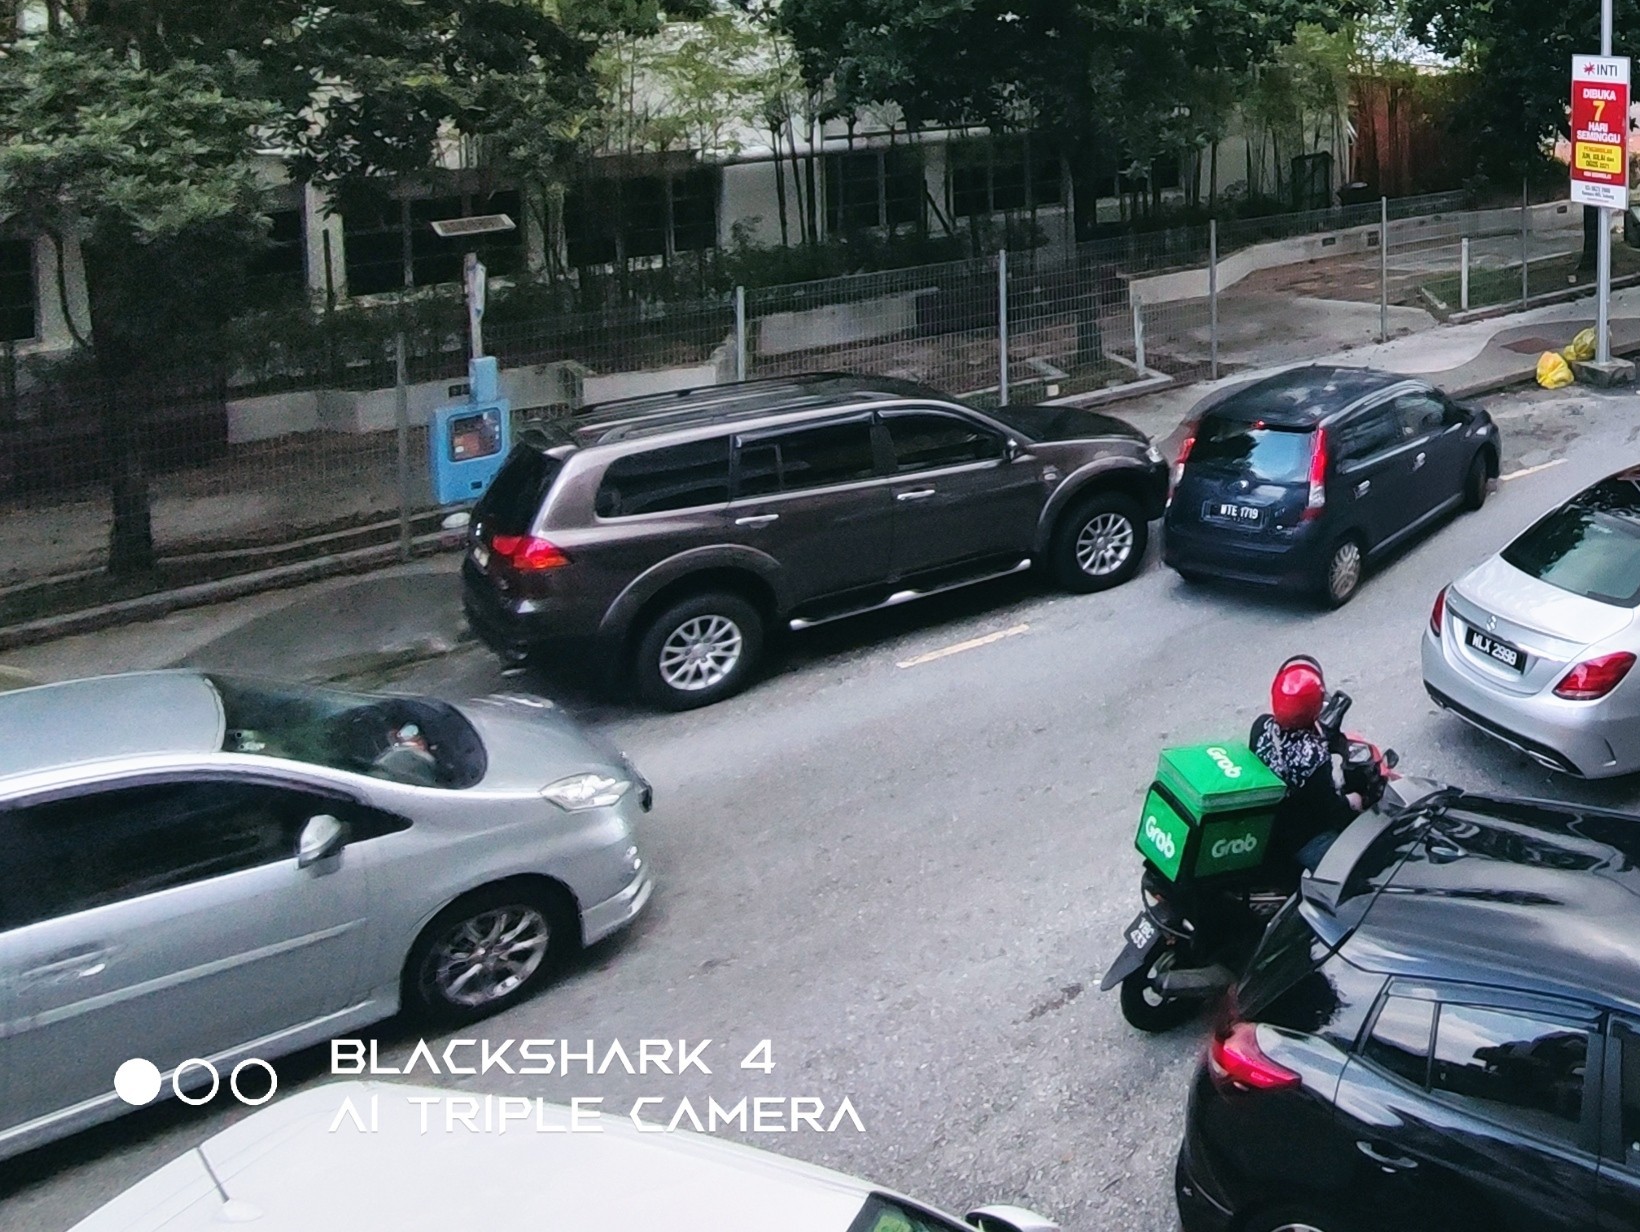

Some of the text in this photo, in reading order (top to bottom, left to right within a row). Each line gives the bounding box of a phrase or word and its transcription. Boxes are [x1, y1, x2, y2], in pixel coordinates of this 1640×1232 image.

[1597, 64, 1617, 77] INTI
[1583, 88, 1616, 101] DIBUKA
[1593, 100, 1605, 122] 7
[1588, 122, 1608, 133] HARI
[1577, 130, 1620, 144] SEMINGGU
[1207, 747, 1242, 778] Grab
[1145, 816, 1175, 859] Grab
[1212, 834, 1257, 858] Grab
